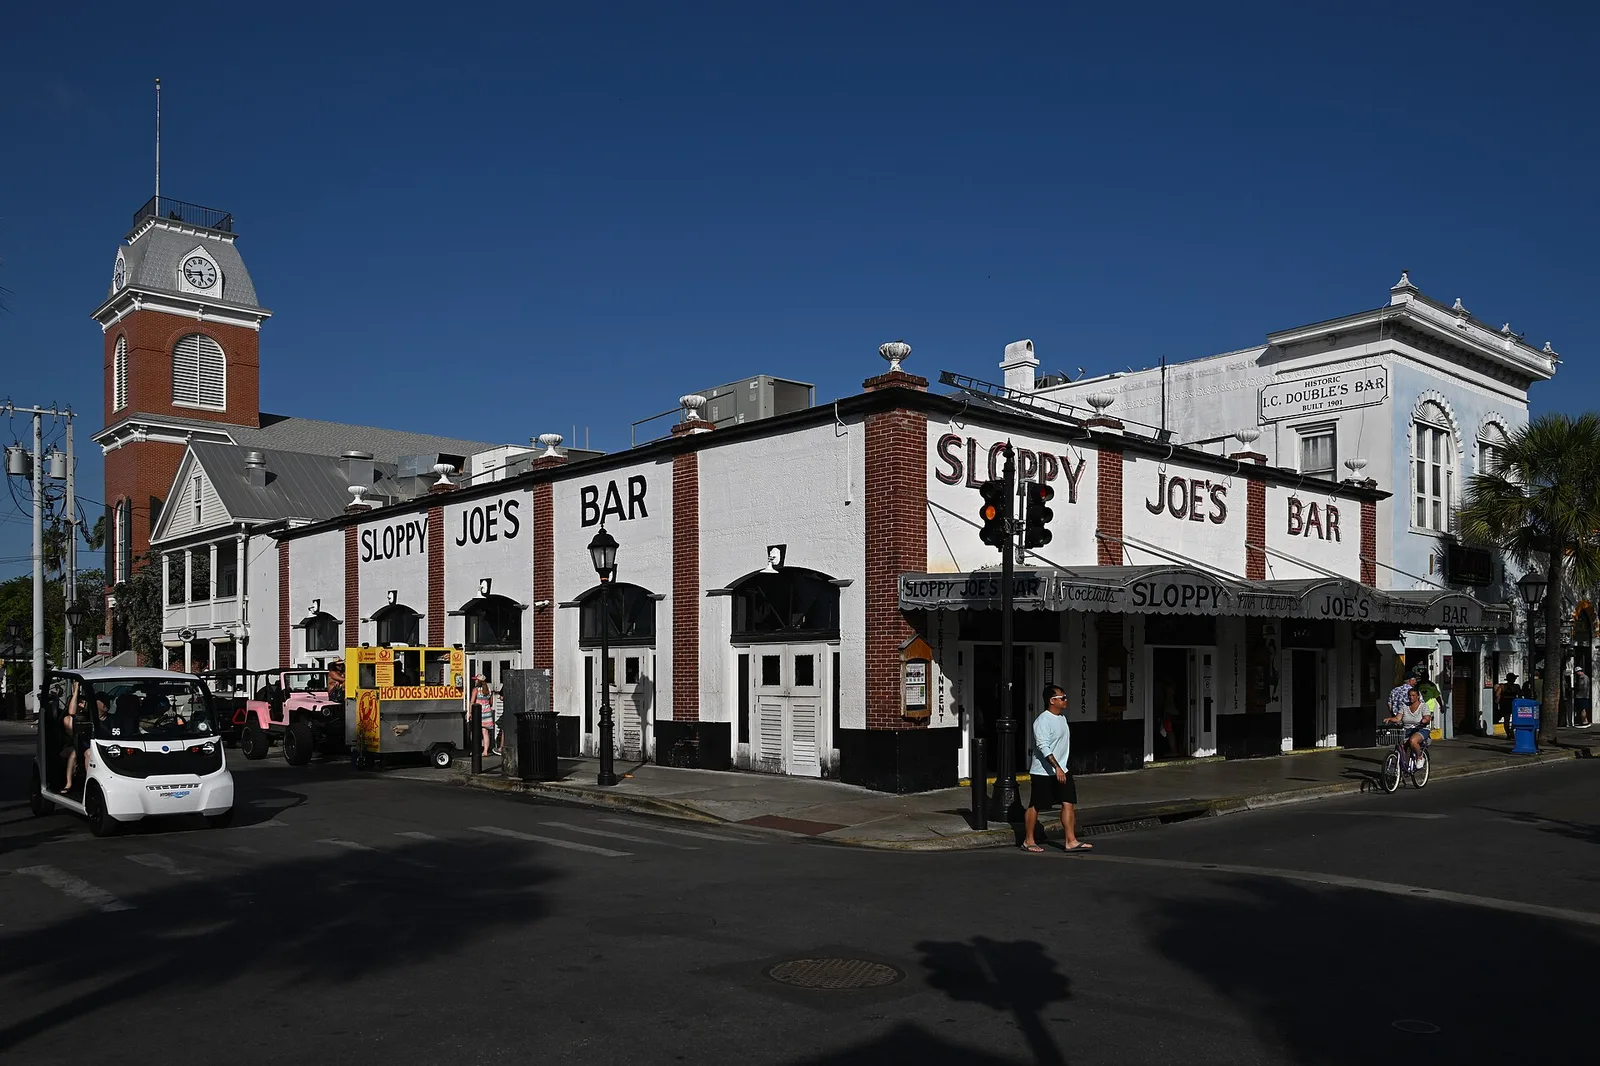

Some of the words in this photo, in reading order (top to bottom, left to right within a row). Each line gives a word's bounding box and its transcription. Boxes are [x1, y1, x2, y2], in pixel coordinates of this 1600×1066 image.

[1286, 383, 1349, 404] DOUBLE'S
[1354, 377, 1386, 393] BAR
[1304, 375, 1341, 388] HISTORIC
[1302, 402, 1324, 412] BUILT
[1327, 399, 1343, 407] 1901
[580, 474, 649, 528] BAR
[1146, 471, 1228, 525] JOE'S
[455, 498, 520, 547] JOE'S
[1287, 495, 1342, 542] BAR
[361, 517, 428, 563] SLOPPY
[904, 580, 955, 597] SLOPPY
[960, 578, 998, 596] JOE'S
[1012, 578, 1039, 597] AR
[1132, 582, 1223, 609] SLOPPY
[1321, 595, 1369, 618] JOE'S
[1442, 605, 1469, 624] BAR
[380, 687, 398, 699] HOT
[399, 686, 422, 699] DOGS
[423, 686, 463, 699] SAUSAGES
[111, 727, 121, 736] 56
